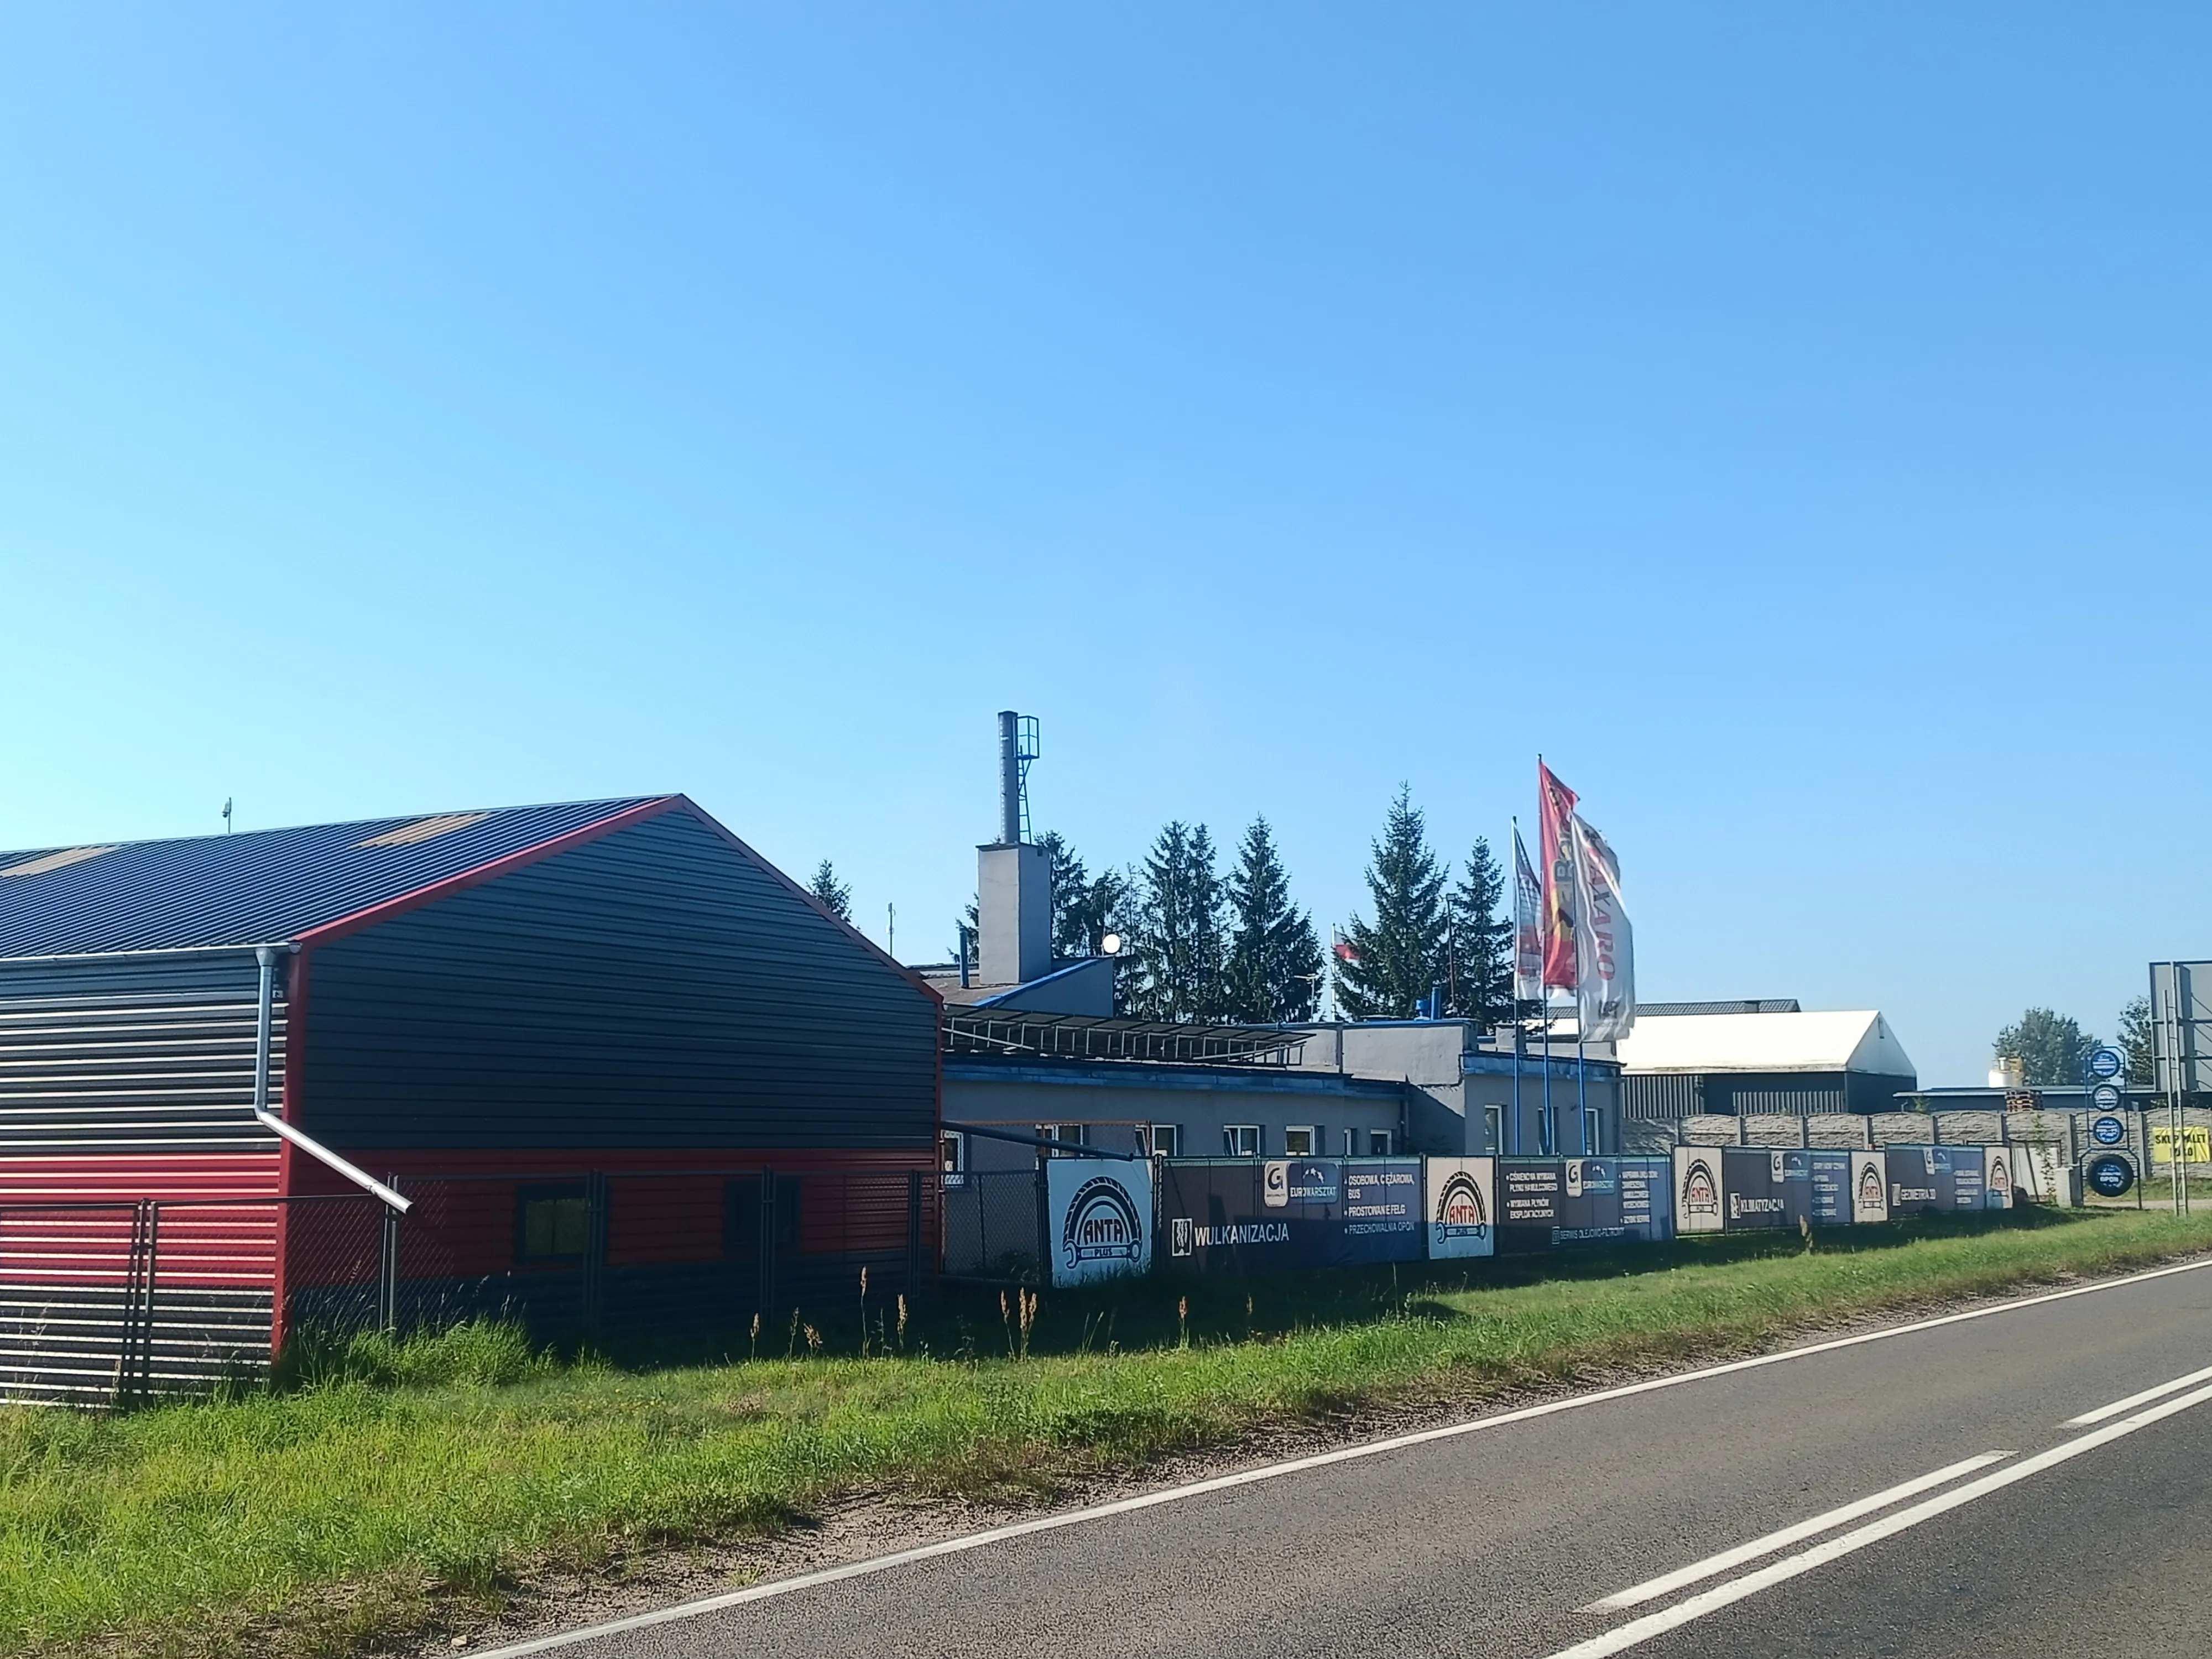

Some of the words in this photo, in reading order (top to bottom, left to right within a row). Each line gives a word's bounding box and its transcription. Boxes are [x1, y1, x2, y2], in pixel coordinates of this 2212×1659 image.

[1380, 1172, 1415, 1187] CĘŻAROWA,
[1290, 1186, 1337, 1198] EUROWARSZTAT
[1348, 1188, 1361, 1199] BUS
[1692, 1187, 1709, 1203] ANTA
[1348, 1205, 1390, 1217] PROSTOWANE
[1391, 1204, 1406, 1215] FELG
[1449, 1205, 1475, 1225] ANTA
[1083, 1218, 1124, 1245] ANTA
[1397, 1220, 1415, 1232] OPON
[1194, 1223, 1290, 1246] WULKANIZACJA
[1094, 1248, 1113, 1257] PLUS
